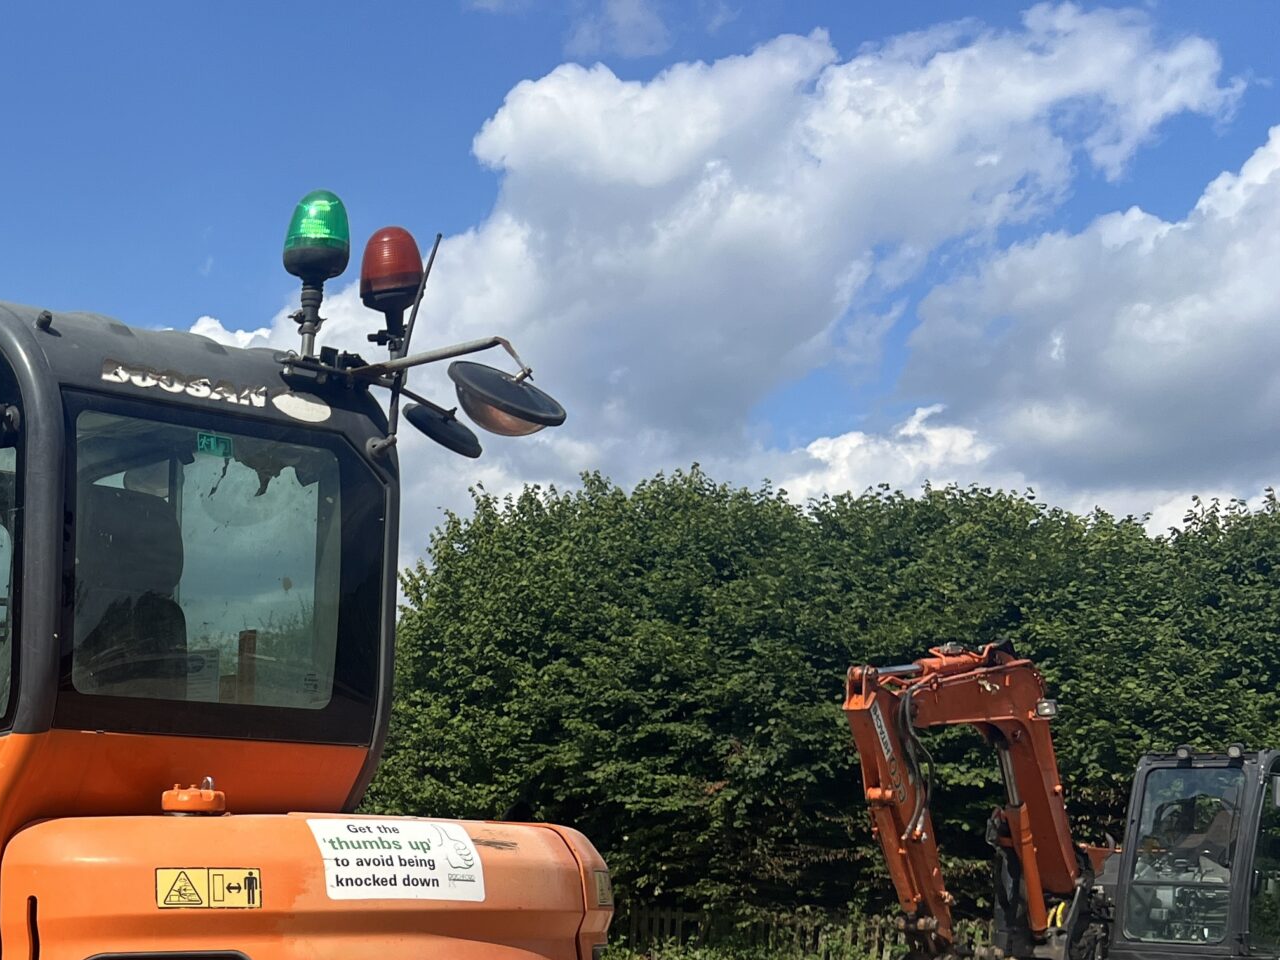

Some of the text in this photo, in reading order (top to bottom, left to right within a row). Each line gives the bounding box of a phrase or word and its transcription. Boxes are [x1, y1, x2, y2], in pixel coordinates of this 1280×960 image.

[871, 703, 891, 757] HITACHI
[346, 824, 400, 834] Get the
[322, 836, 432, 854] 'thumbs up'
[334, 855, 436, 870] to avoid being
[335, 874, 398, 887] knocked
[402, 874, 440, 888] down
